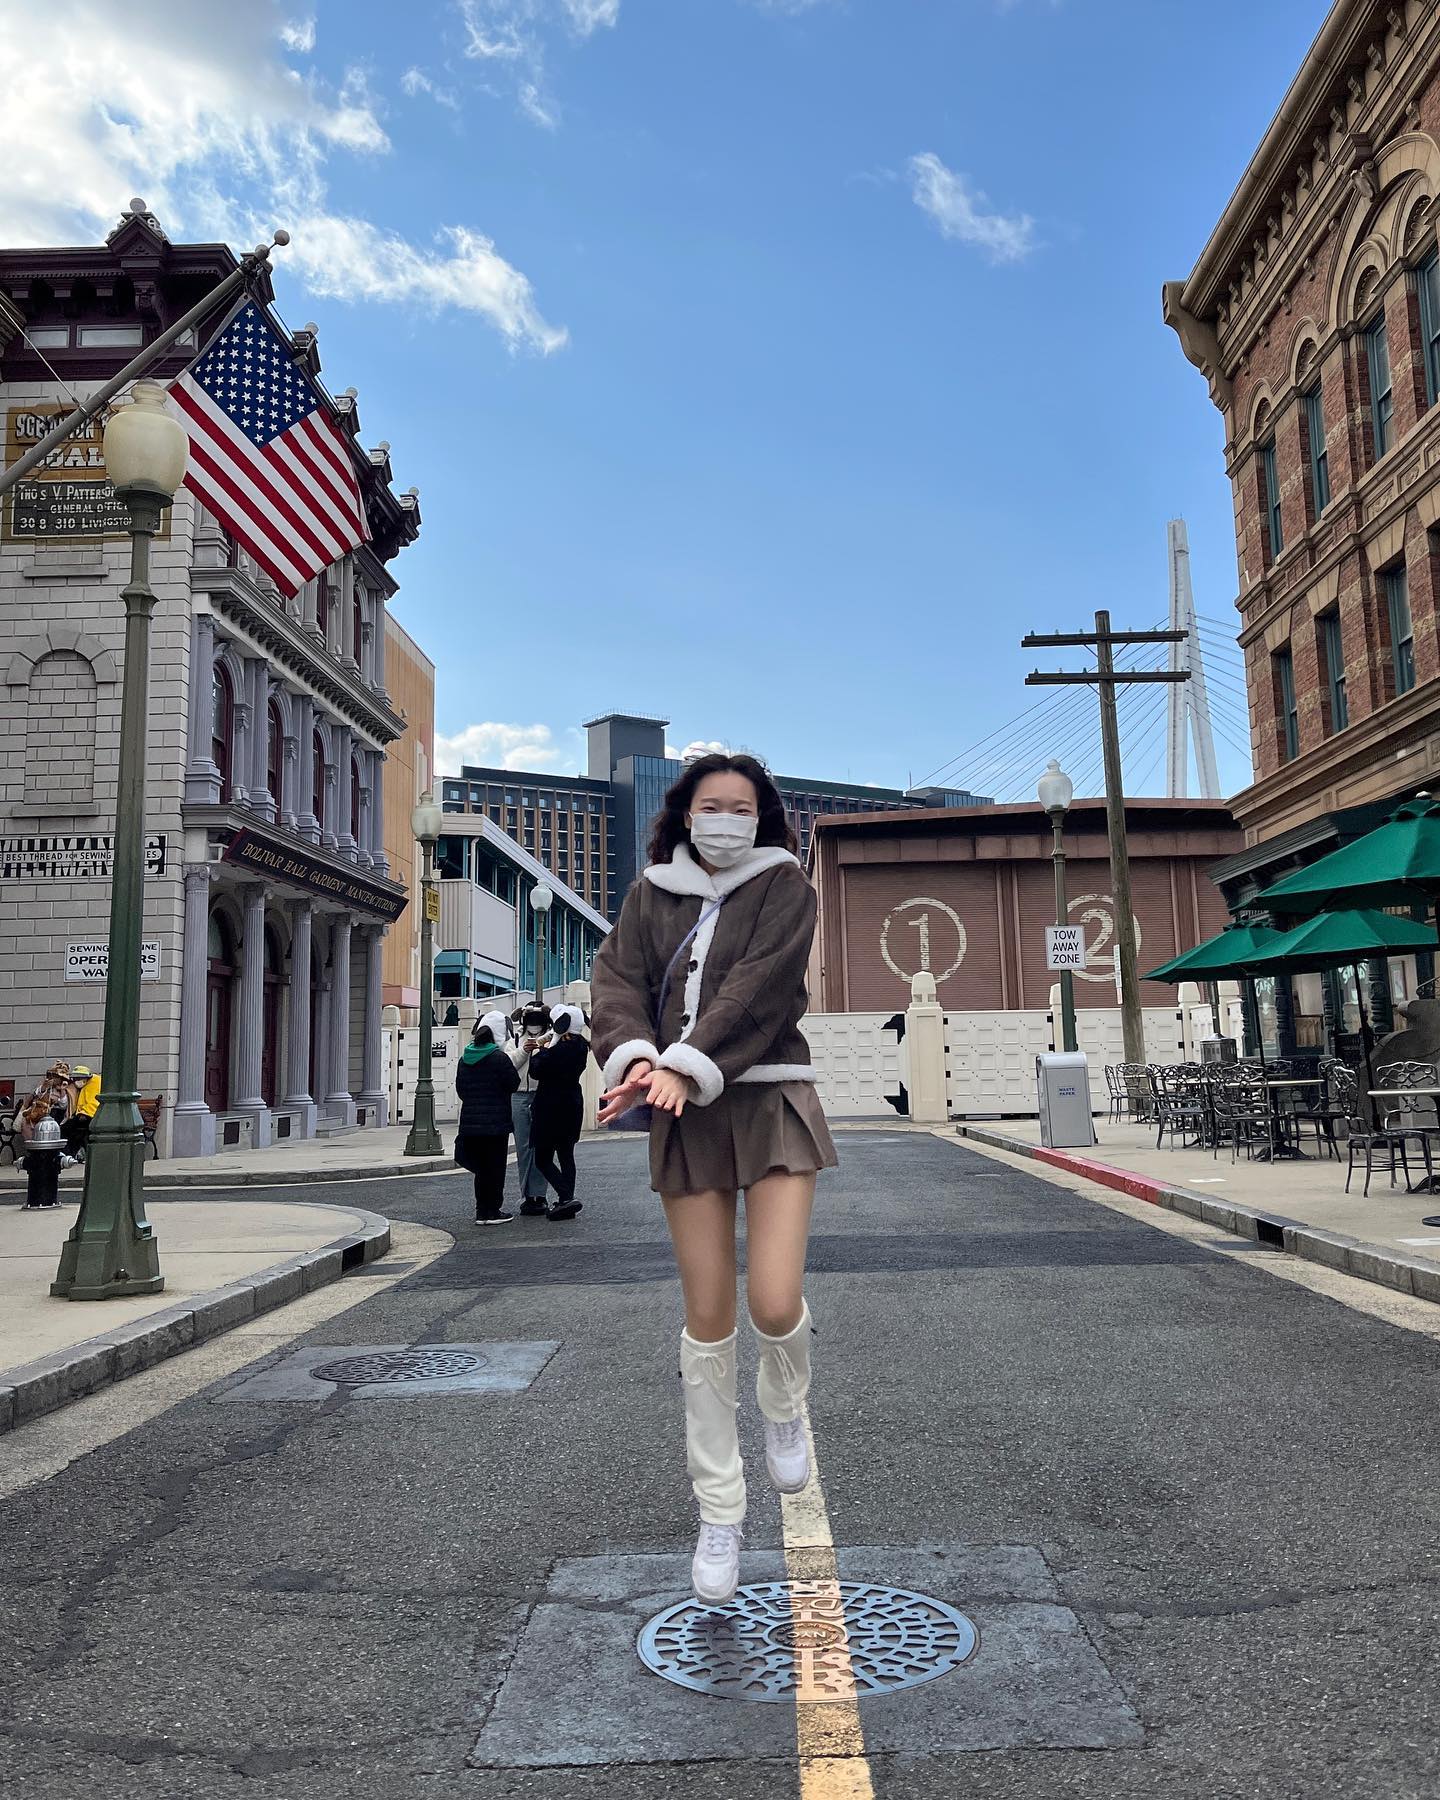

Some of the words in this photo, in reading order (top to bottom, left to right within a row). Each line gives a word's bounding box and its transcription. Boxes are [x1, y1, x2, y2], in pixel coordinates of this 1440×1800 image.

[24, 447, 104, 467] OAL
[50, 504, 94, 514] GENERAL
[55, 517, 76, 529] 310
[6, 853, 27, 862] BEST
[29, 852, 63, 861] THREAD
[80, 851, 112, 861] SEWING
[241, 842, 284, 868] BOLIVAR
[283, 860, 308, 878] HALL
[309, 870, 347, 892] GARMENT
[346, 885, 398, 912] MANUFACTURING
[1053, 930, 1077, 940] TOW
[1080, 909, 1116, 965] 2
[908, 914, 930, 970] 1
[1052, 942, 1080, 952] AWAY
[69, 944, 109, 953] SEWING
[68, 954, 156, 966] OPERRS
[1053, 953, 1080, 964] ZONE
[787, 1631, 827, 1639] NYC
